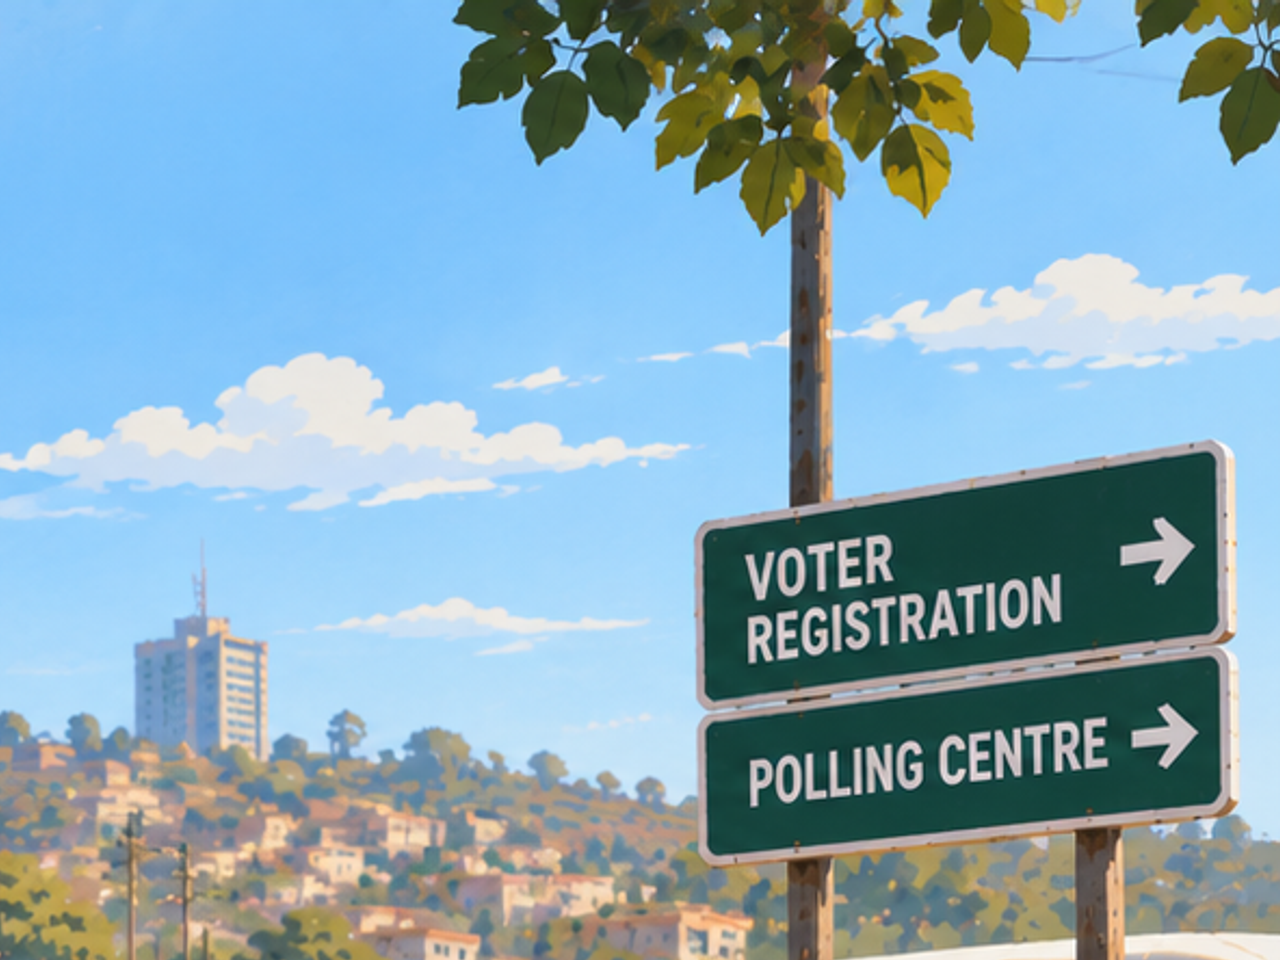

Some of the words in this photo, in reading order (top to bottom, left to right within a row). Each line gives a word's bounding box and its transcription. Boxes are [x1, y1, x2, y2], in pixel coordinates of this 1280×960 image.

[745, 534, 894, 601] VOTER
[747, 573, 1062, 664] REGISTRATION
[749, 740, 924, 808] POLLING
[939, 716, 1109, 785] CENTRE
